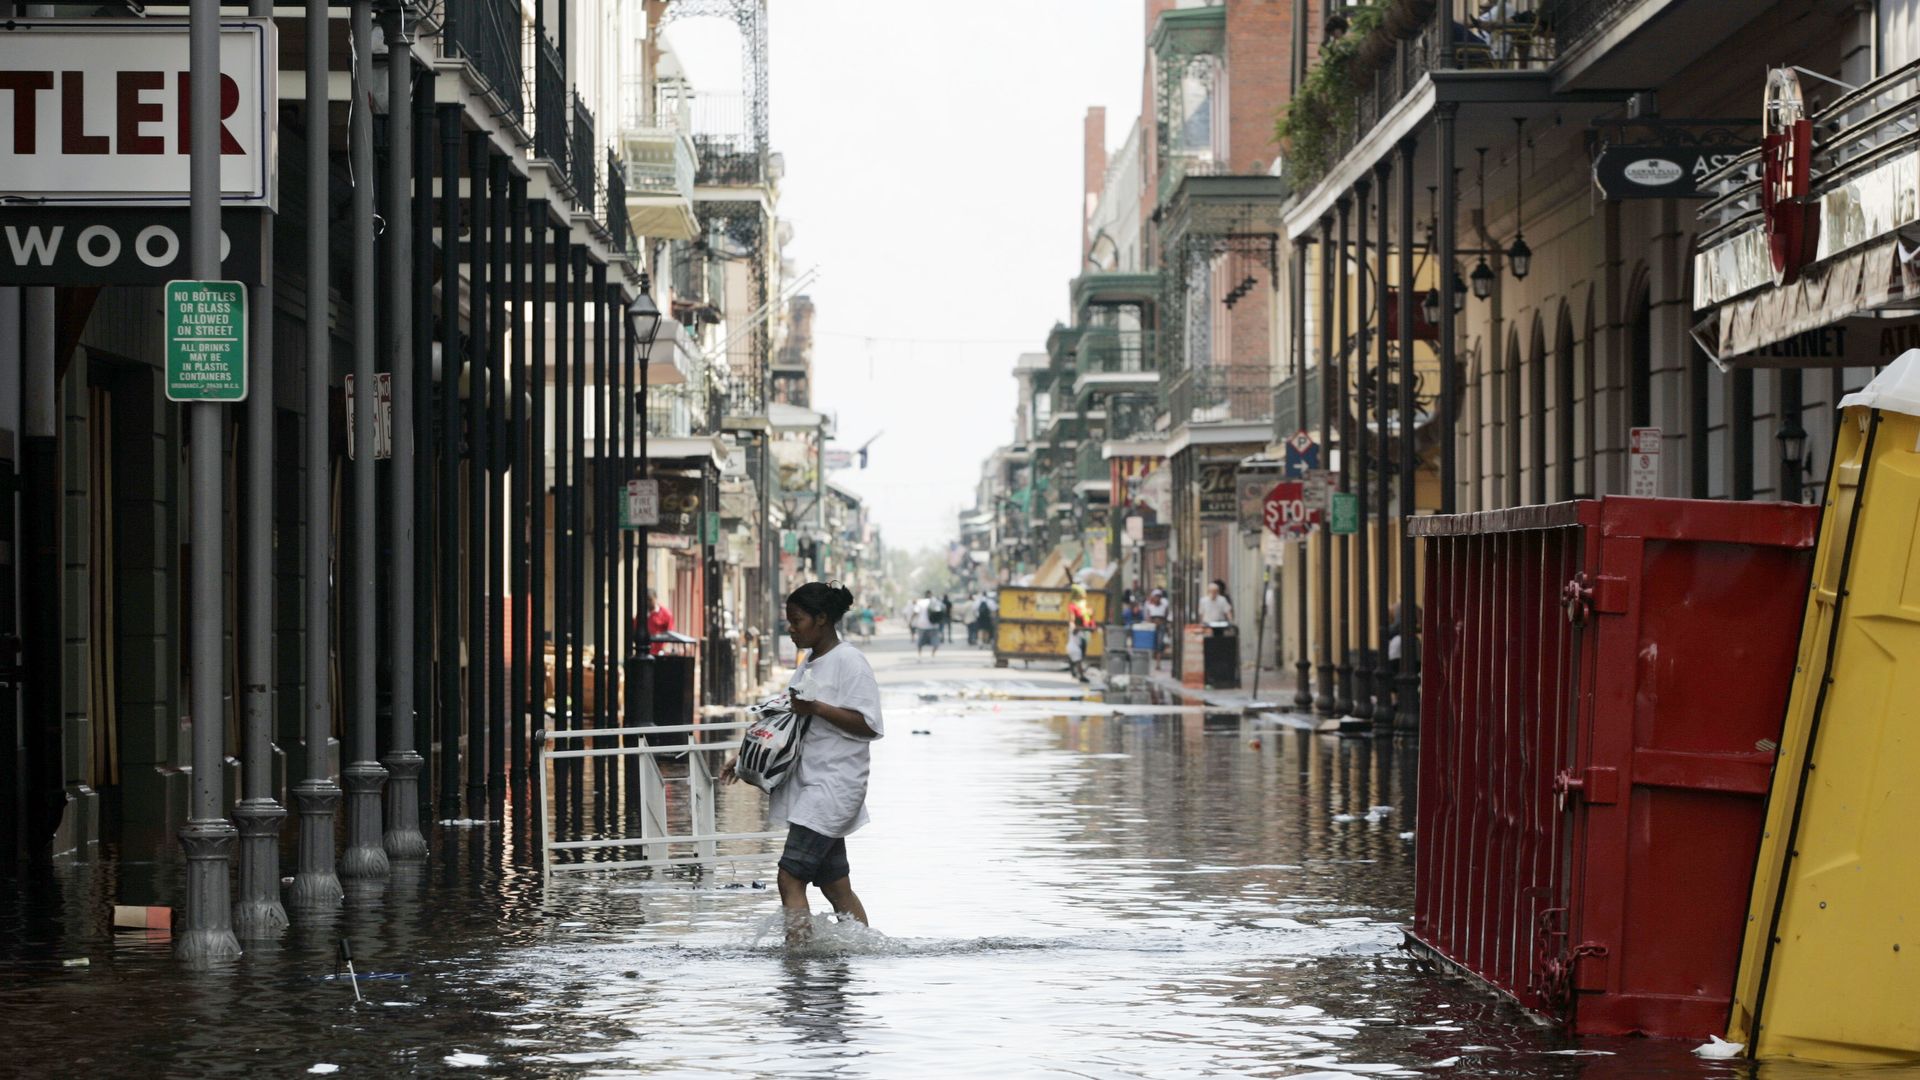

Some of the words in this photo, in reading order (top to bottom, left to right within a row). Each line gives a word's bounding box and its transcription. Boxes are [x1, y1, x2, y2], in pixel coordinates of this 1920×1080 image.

[5, 224, 231, 268] WOO
[174, 291, 188, 302] NO
[192, 291, 236, 302] BOTTLES
[180, 303, 193, 313] OR
[198, 303, 231, 313] GLASS
[182, 314, 229, 324] ALLOWED
[177, 326, 191, 336] ON
[195, 326, 233, 336] STREET
[181, 343, 196, 352] ALL
[199, 343, 231, 352] DRINKS
[189, 353, 208, 362] MAY
[210, 353, 222, 362] BE
[183, 362, 191, 371] IN
[195, 362, 229, 371] PLASTIC
[179, 372, 232, 381] CONTAINERS
